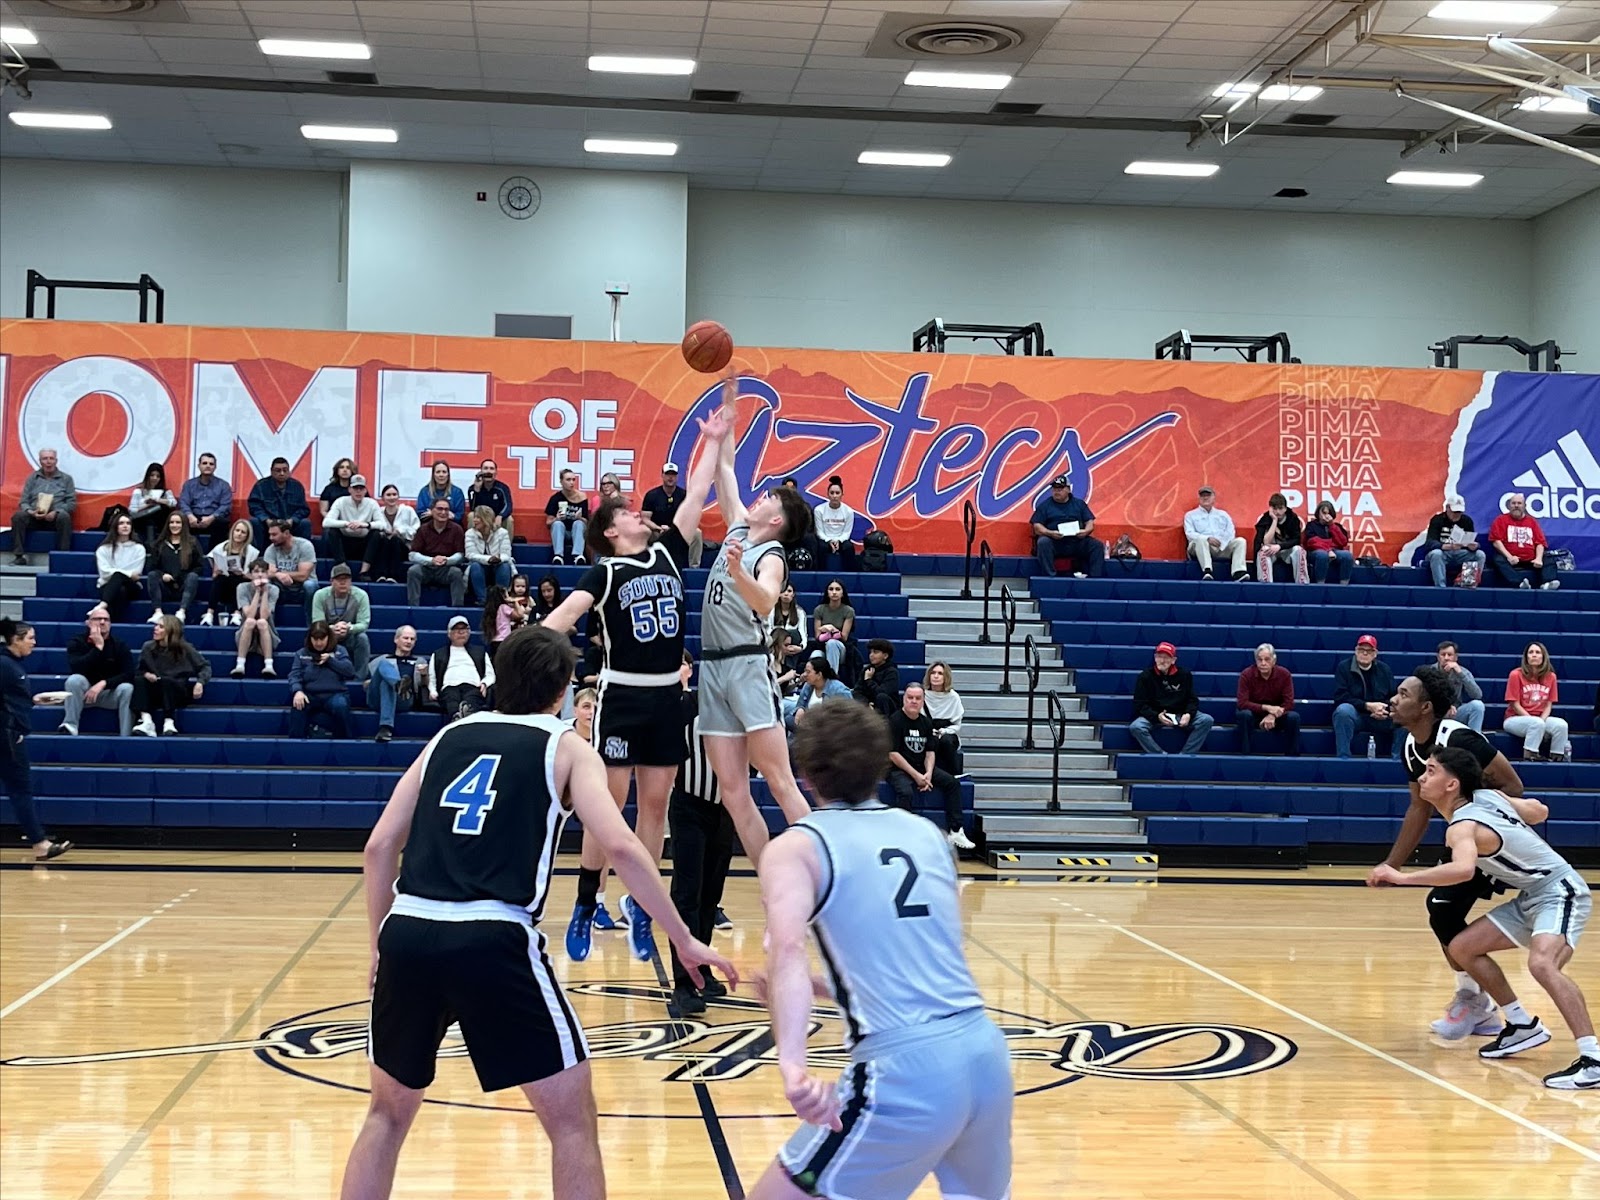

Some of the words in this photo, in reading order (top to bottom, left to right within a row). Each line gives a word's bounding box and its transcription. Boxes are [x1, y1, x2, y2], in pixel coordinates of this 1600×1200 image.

[1279, 381, 1381, 410] PIMA
[528, 397, 618, 443] OF
[1280, 408, 1381, 437] PIMA
[507, 445, 635, 491] THE
[1280, 435, 1382, 463] PIMA
[1280, 461, 1382, 490] PIMA
[1280, 489, 1383, 516] PIMA
[618, 573, 683, 611] SOUTH
[630, 596, 681, 643] 55
[439, 753, 502, 836] 4
[879, 847, 931, 919] 2
